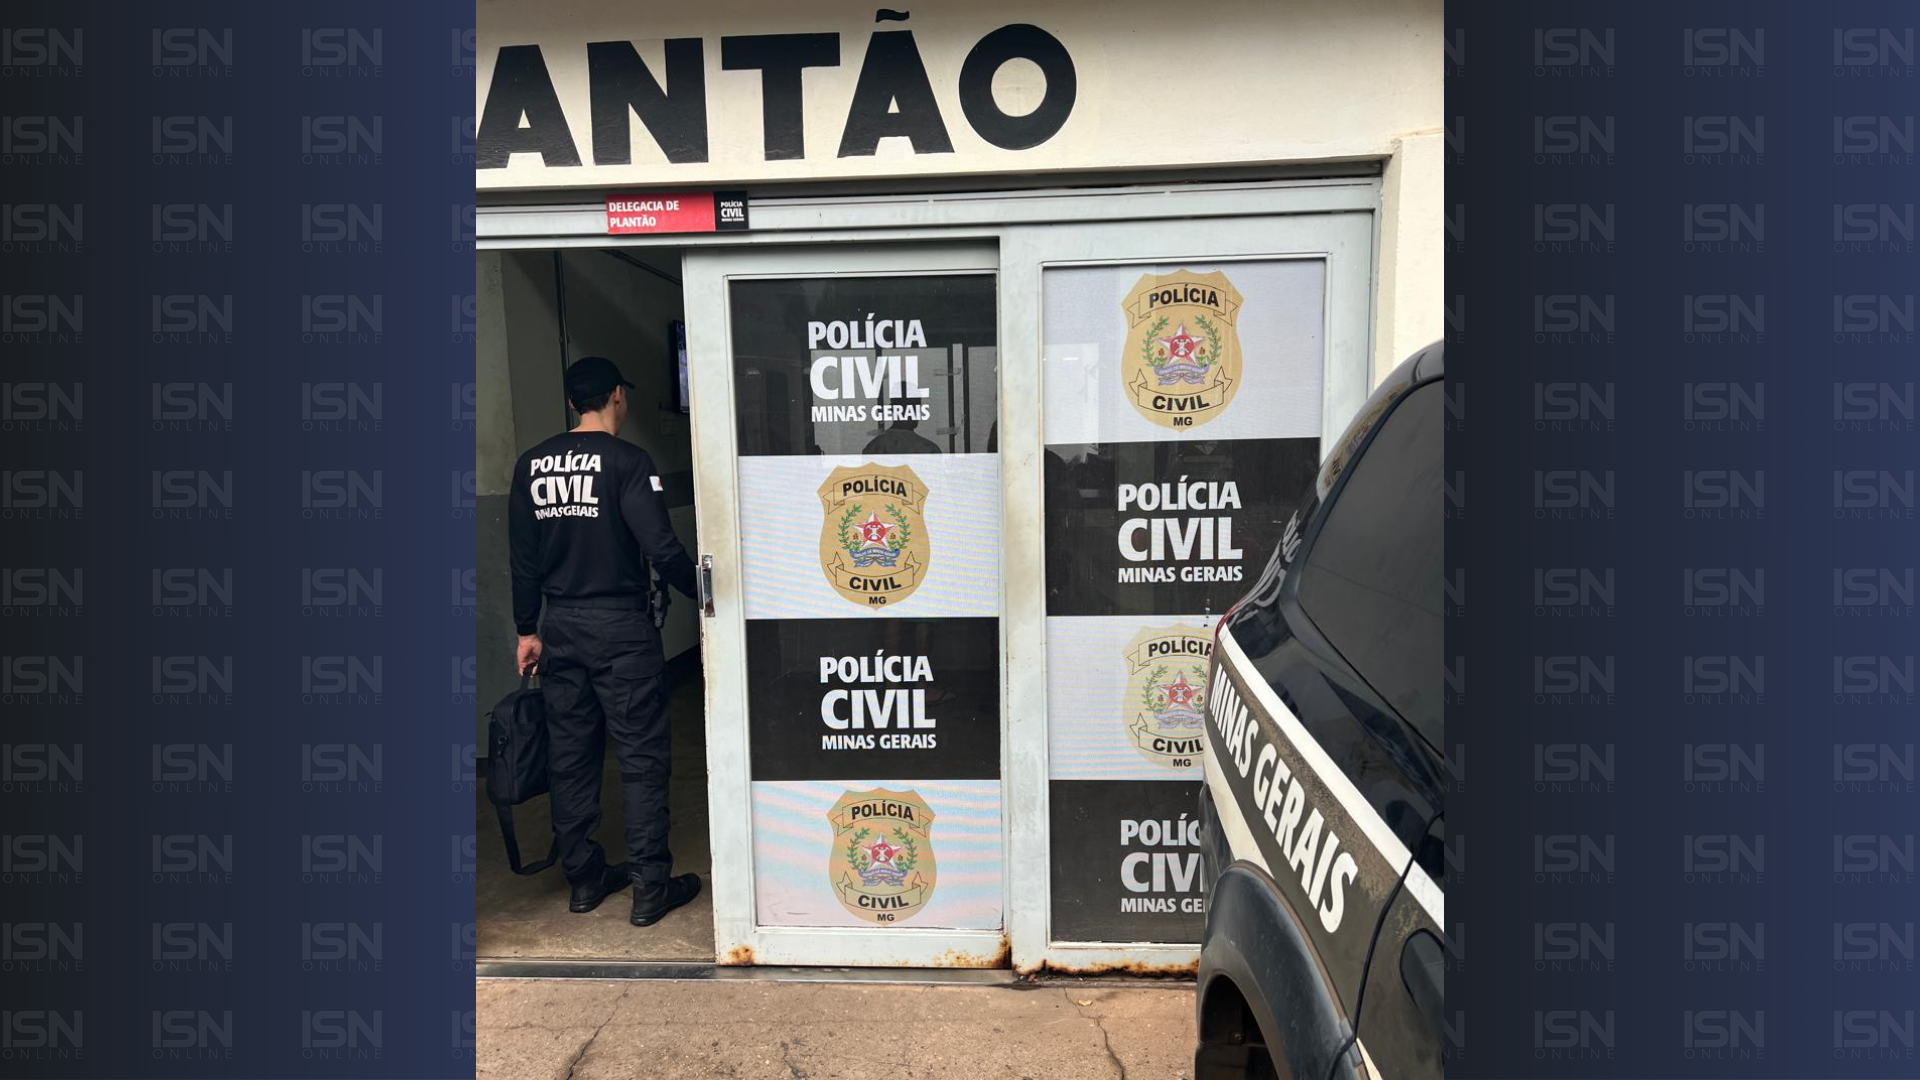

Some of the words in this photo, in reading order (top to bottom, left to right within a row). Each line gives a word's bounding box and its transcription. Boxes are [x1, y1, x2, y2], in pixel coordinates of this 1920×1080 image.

[609, 202, 664, 212] DELEGACIA
[666, 201, 680, 211] DE
[720, 200, 744, 208] POLÍCIA
[721, 208, 744, 218] CIVIL
[610, 215, 657, 228] PLANTÃO
[1149, 284, 1219, 308] POLÍCIA
[808, 313, 927, 349] POLÍCIA
[809, 355, 930, 400] CIVIL
[1152, 395, 1210, 411] CIVIL
[811, 405, 866, 422] MINAS
[871, 404, 931, 421] GERAIS
[1173, 417, 1193, 427] MG
[530, 450, 601, 476] POLÍCIA
[530, 475, 599, 506] CIVIL
[842, 476, 907, 497] POLÍCIA
[1118, 475, 1242, 511] POLÍCIA
[1117, 517, 1243, 562] CIVIL
[1118, 567, 1176, 583] MINAS
[1180, 565, 1243, 582] GERAIS
[849, 576, 902, 591] CIVIL
[869, 596, 887, 605] MG
[820, 649, 934, 684] POLÍCIA
[820, 689, 936, 730] CIVIL
[822, 735, 875, 750] MINAS
[879, 734, 937, 749] GERAIS
[1172, 759, 1192, 767] MG
[1209, 662, 1259, 778] MINAS
[1253, 743, 1358, 933] GERAIS
[851, 800, 914, 821] POLÍCIA
[1120, 852, 1204, 893] CIV
[858, 894, 909, 909] CIVIL
[1121, 898, 1177, 913] MINAS
[877, 913, 895, 922] MG
